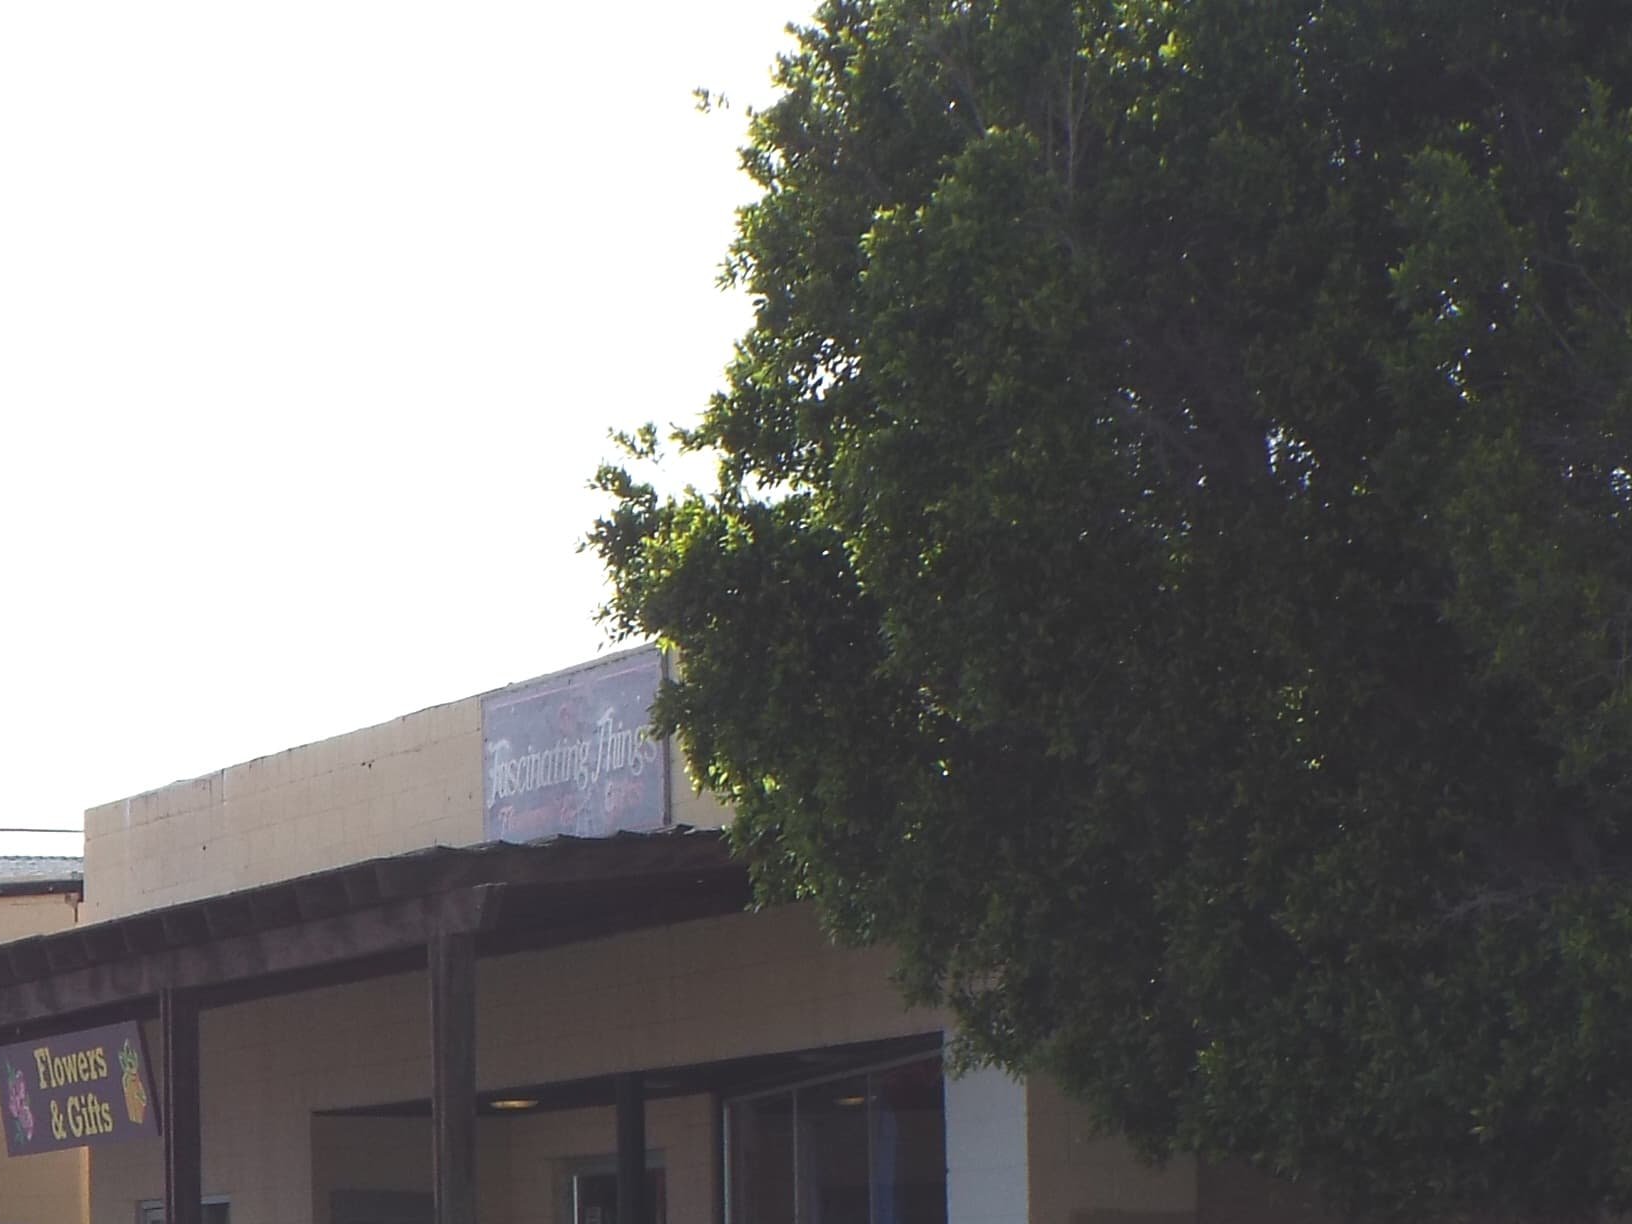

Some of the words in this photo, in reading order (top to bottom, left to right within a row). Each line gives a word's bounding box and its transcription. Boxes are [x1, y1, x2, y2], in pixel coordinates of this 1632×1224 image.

[486, 736, 593, 809] Fascinating
[591, 706, 658, 784] Things
[33, 1046, 109, 1090] Flowers
[49, 1099, 67, 1141] &
[66, 1092, 114, 1138] Gifts
